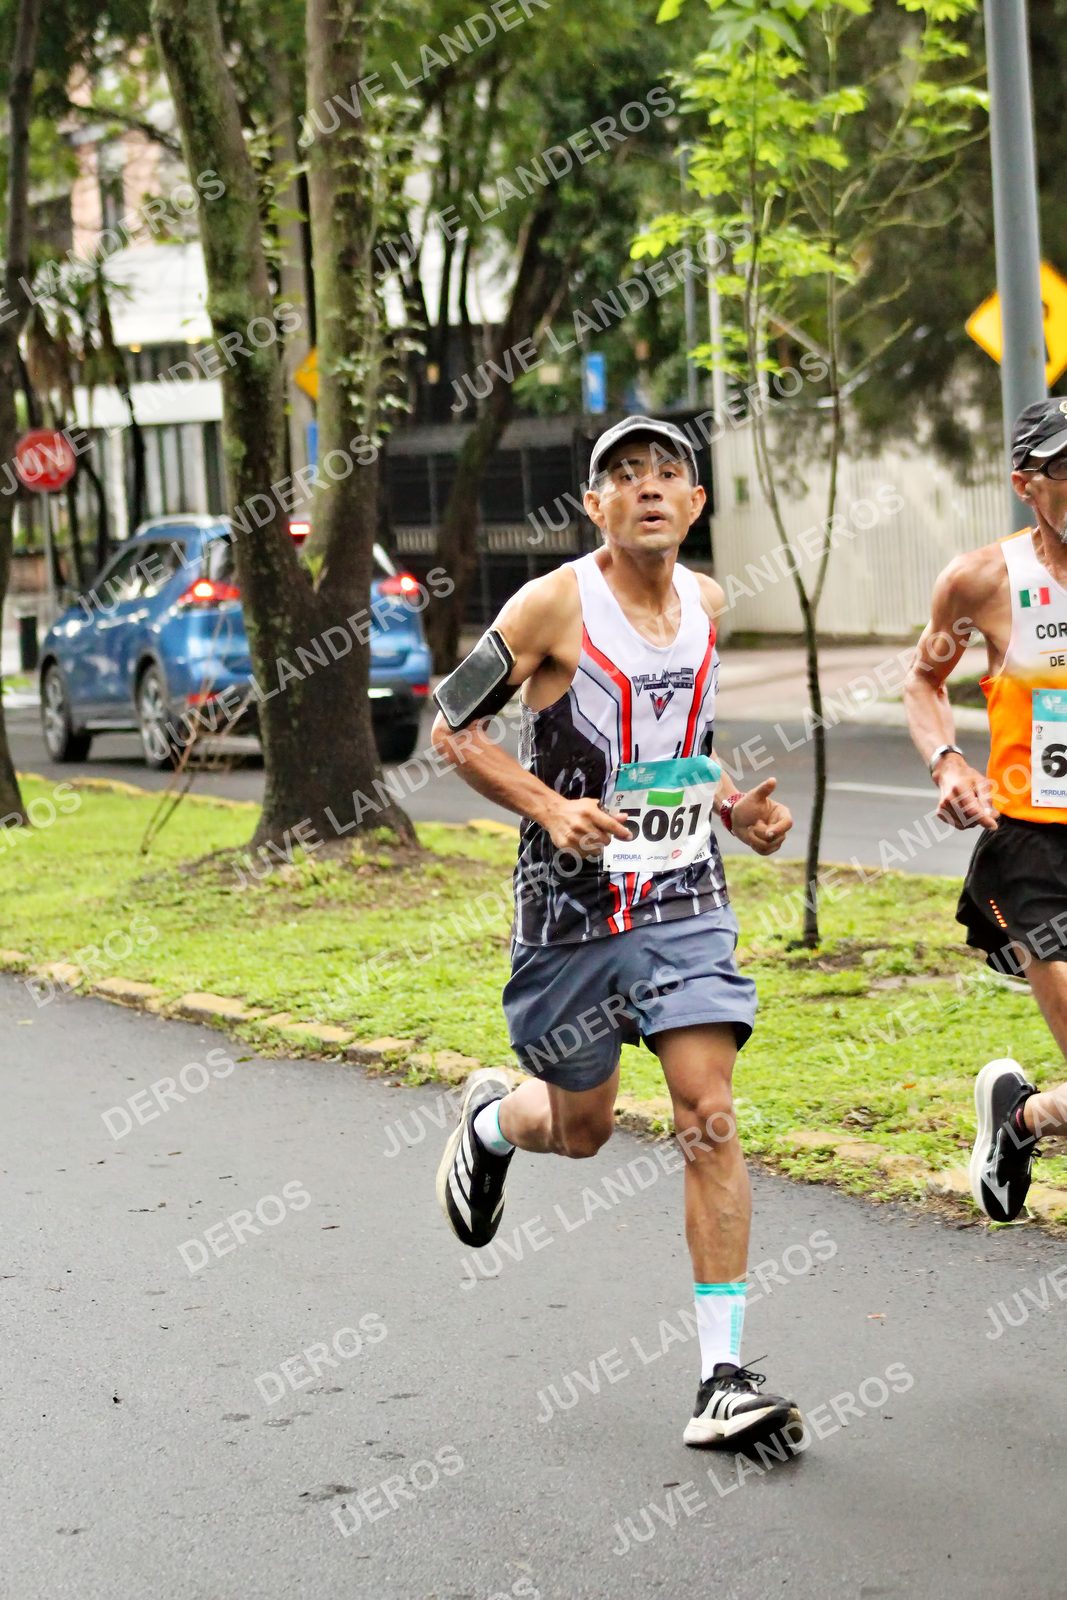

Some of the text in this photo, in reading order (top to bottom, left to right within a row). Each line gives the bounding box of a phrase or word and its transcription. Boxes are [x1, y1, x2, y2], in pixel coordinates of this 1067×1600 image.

[1036, 622, 1067, 640] COR
[1049, 655, 1065, 668] DE
[1041, 743, 1067, 778] 6
[614, 803, 702, 842] 5061
